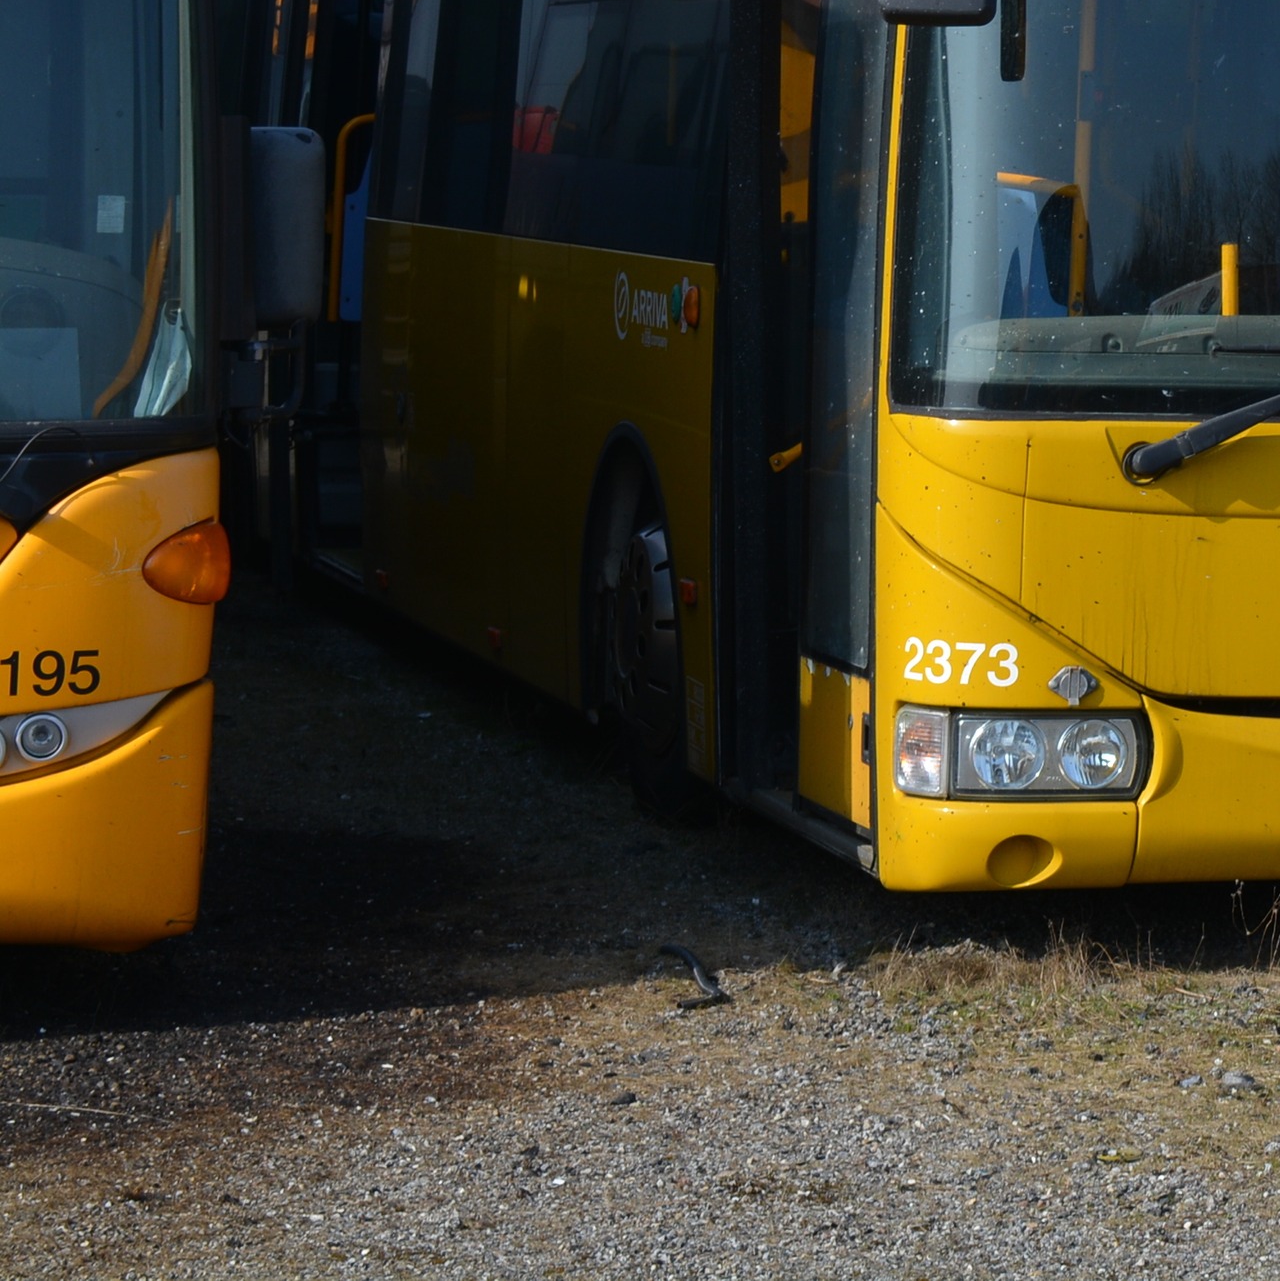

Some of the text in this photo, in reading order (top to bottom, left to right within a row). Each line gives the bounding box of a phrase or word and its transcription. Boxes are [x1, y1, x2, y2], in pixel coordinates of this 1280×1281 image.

[631, 288, 669, 330] ARRIVA
[0, 649, 101, 697] 195
[903, 636, 1019, 687] 2373
